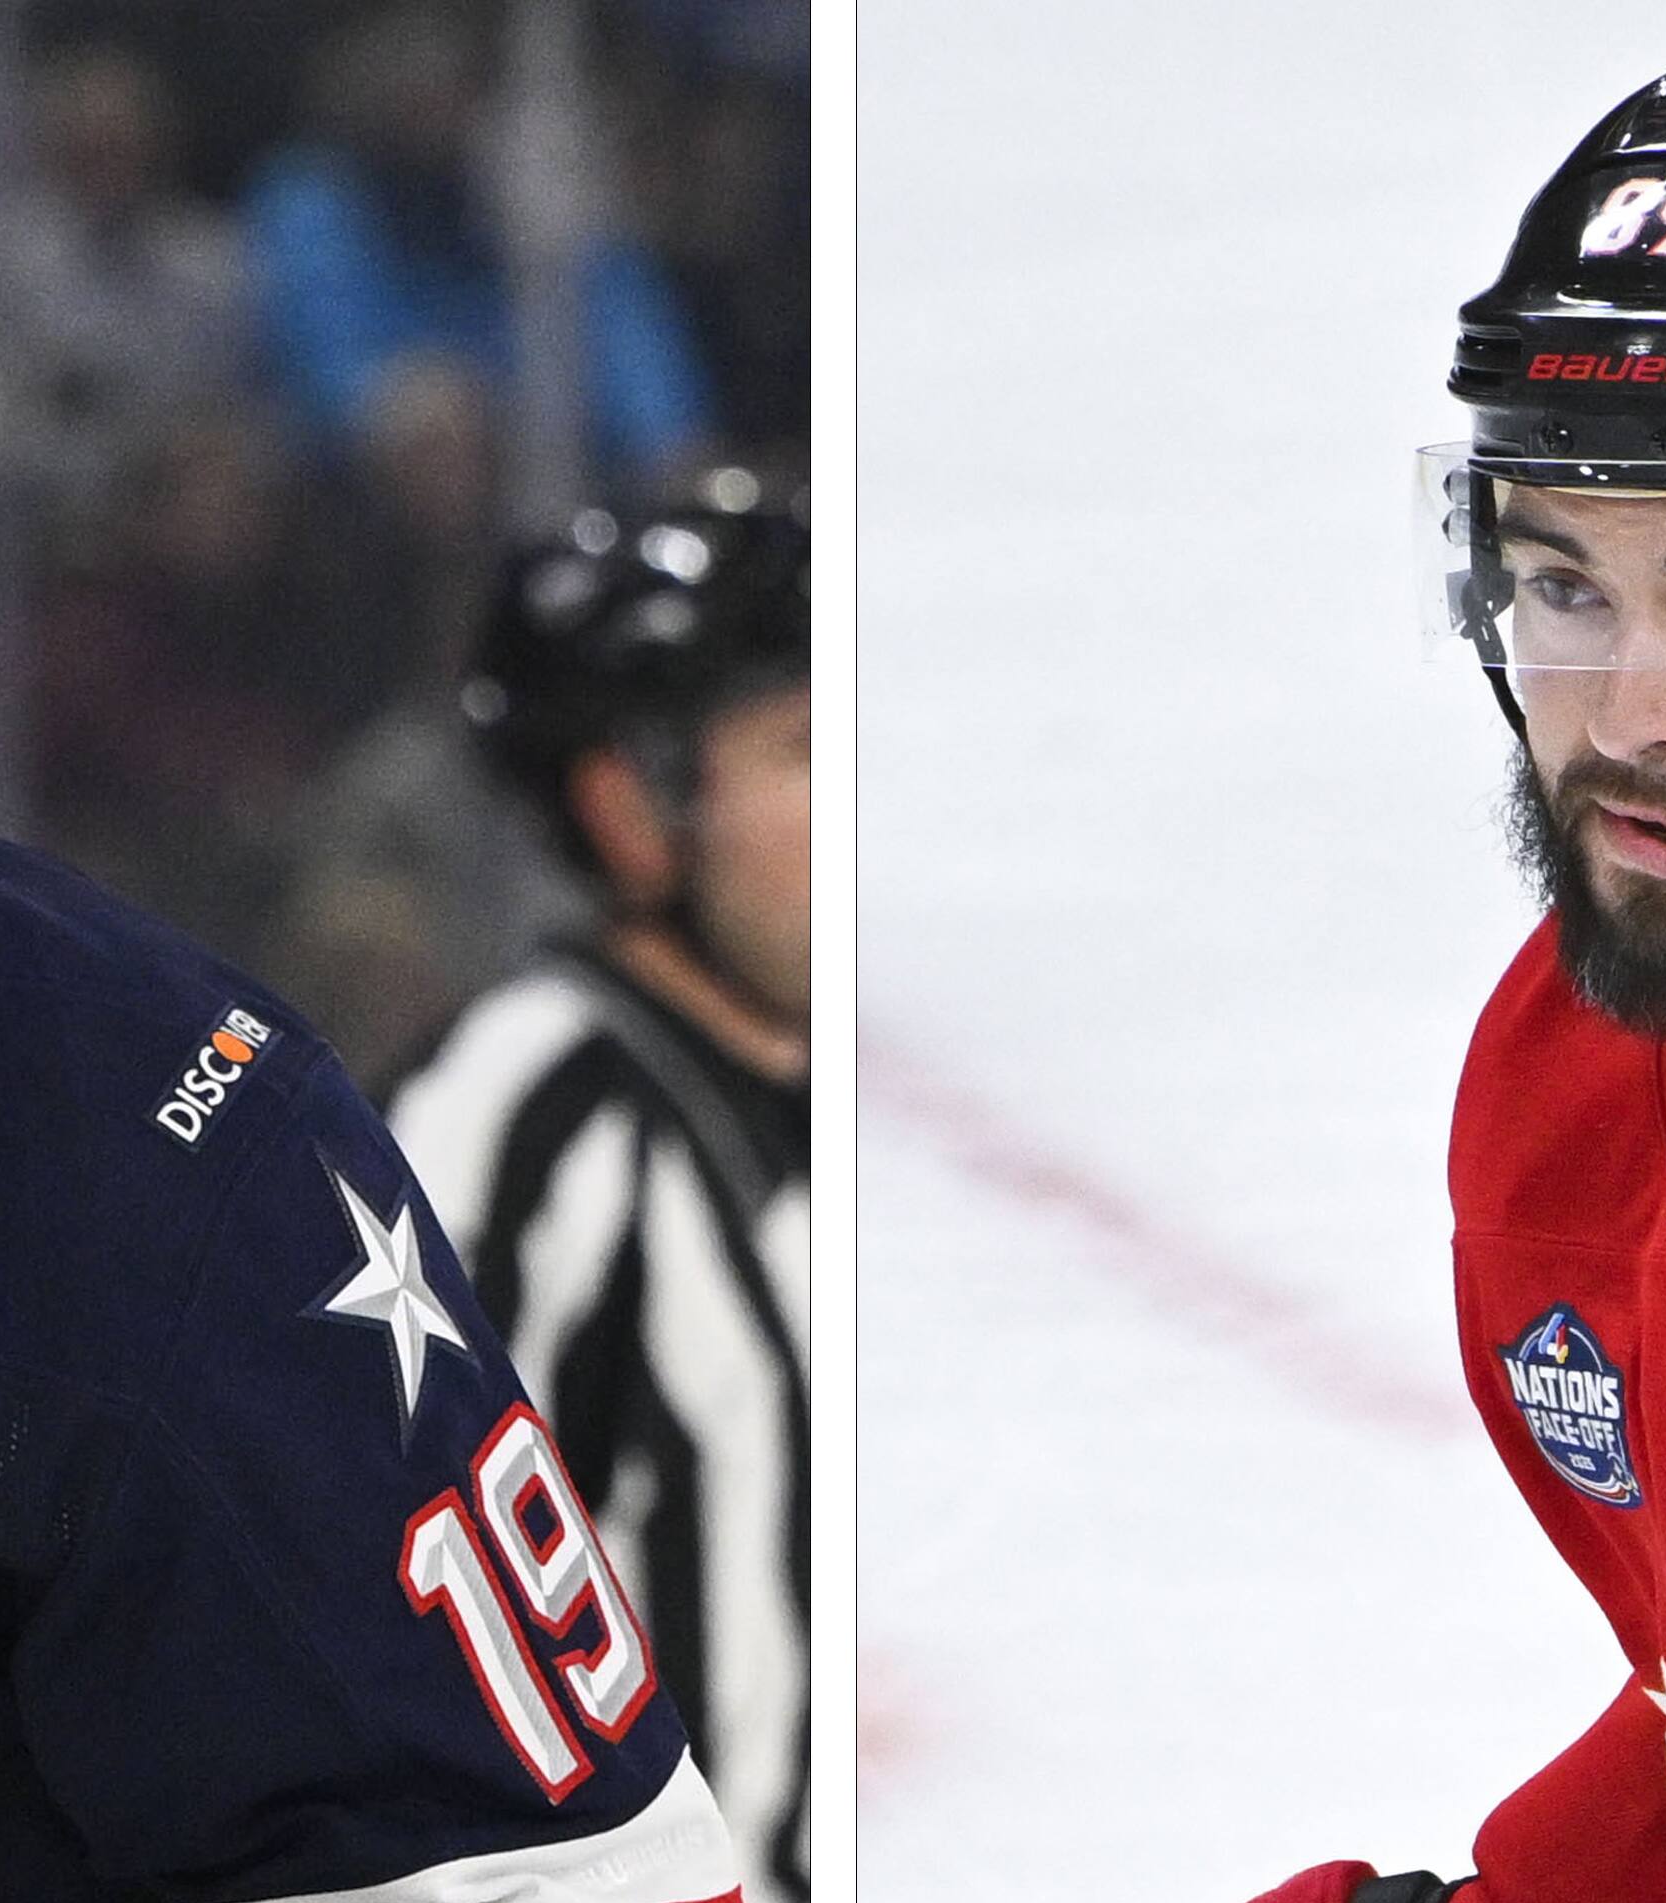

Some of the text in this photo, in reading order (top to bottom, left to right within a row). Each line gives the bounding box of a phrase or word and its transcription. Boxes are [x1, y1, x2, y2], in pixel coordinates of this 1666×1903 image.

[1505, 1358, 1620, 1419] NATIONS
[1532, 1410, 1616, 1451] FACE-OFF
[398, 1400, 656, 1805] 19
